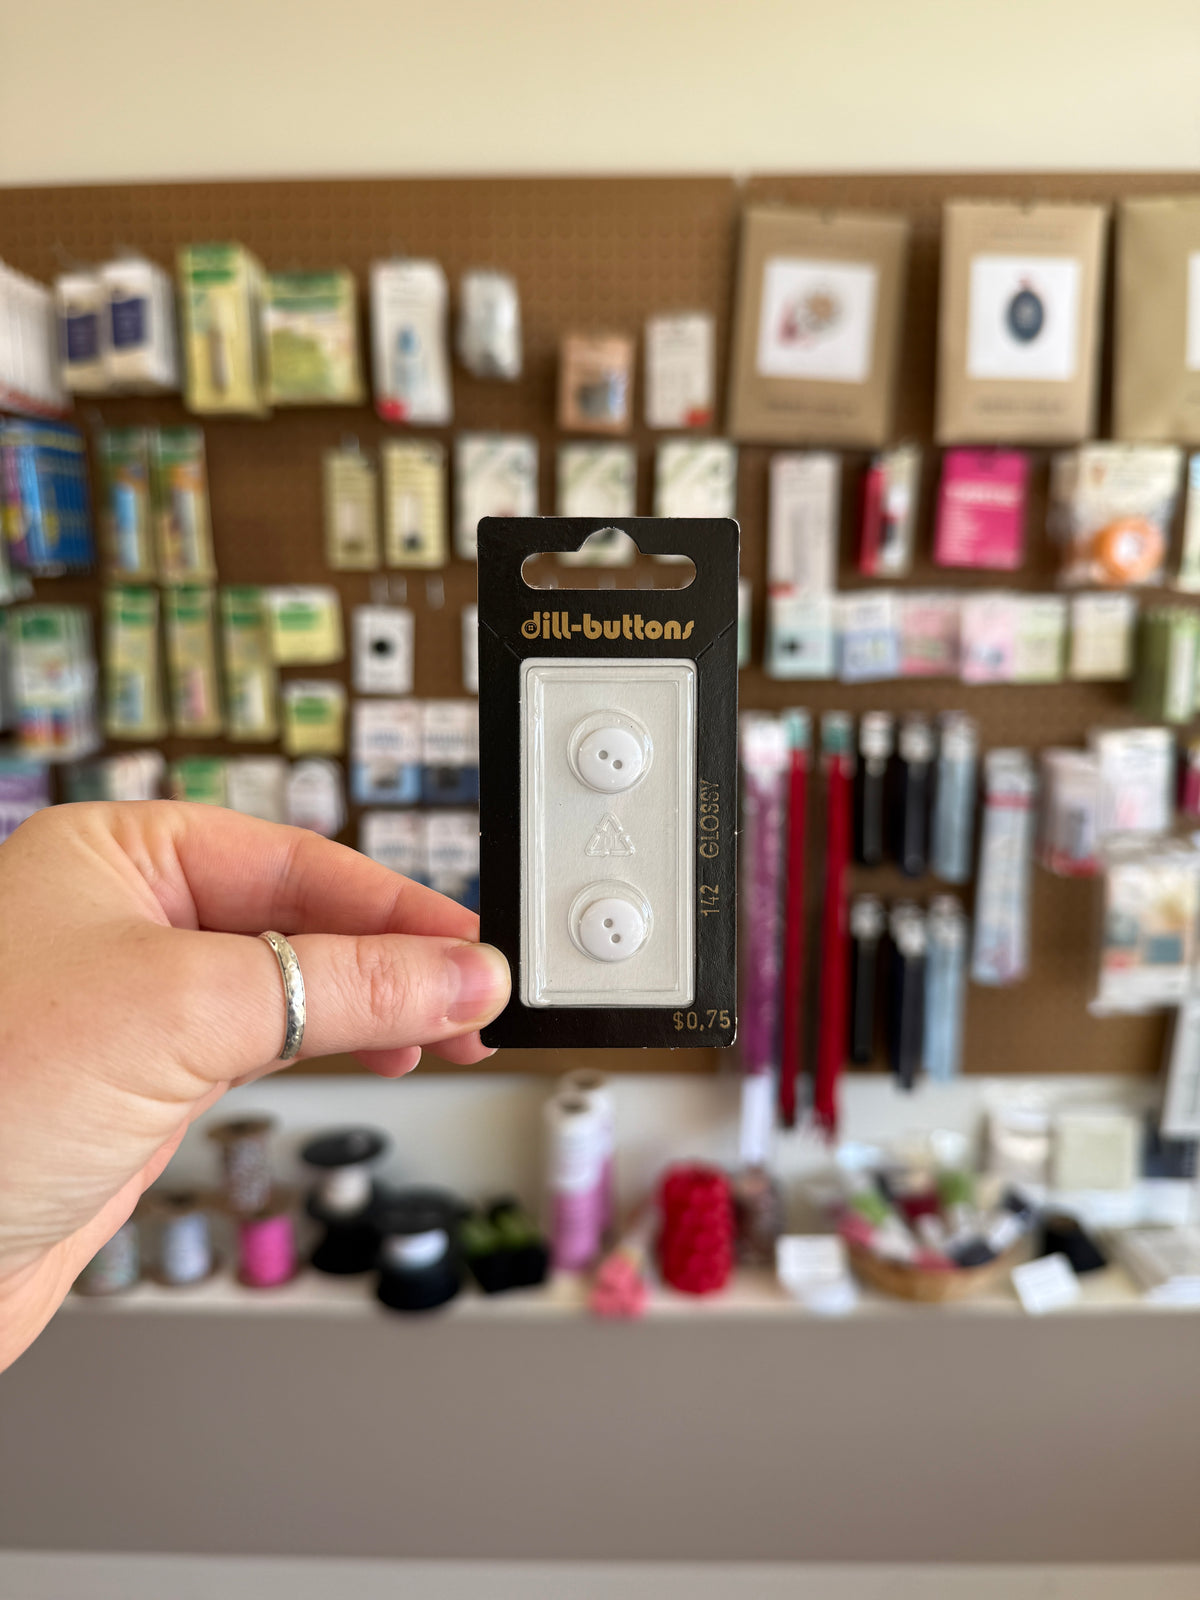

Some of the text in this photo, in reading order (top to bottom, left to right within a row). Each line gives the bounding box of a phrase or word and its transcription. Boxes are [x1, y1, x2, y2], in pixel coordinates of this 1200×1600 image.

[520, 611, 695, 640] dill-buttons
[700, 777, 720, 917] 142 GLOSSY
